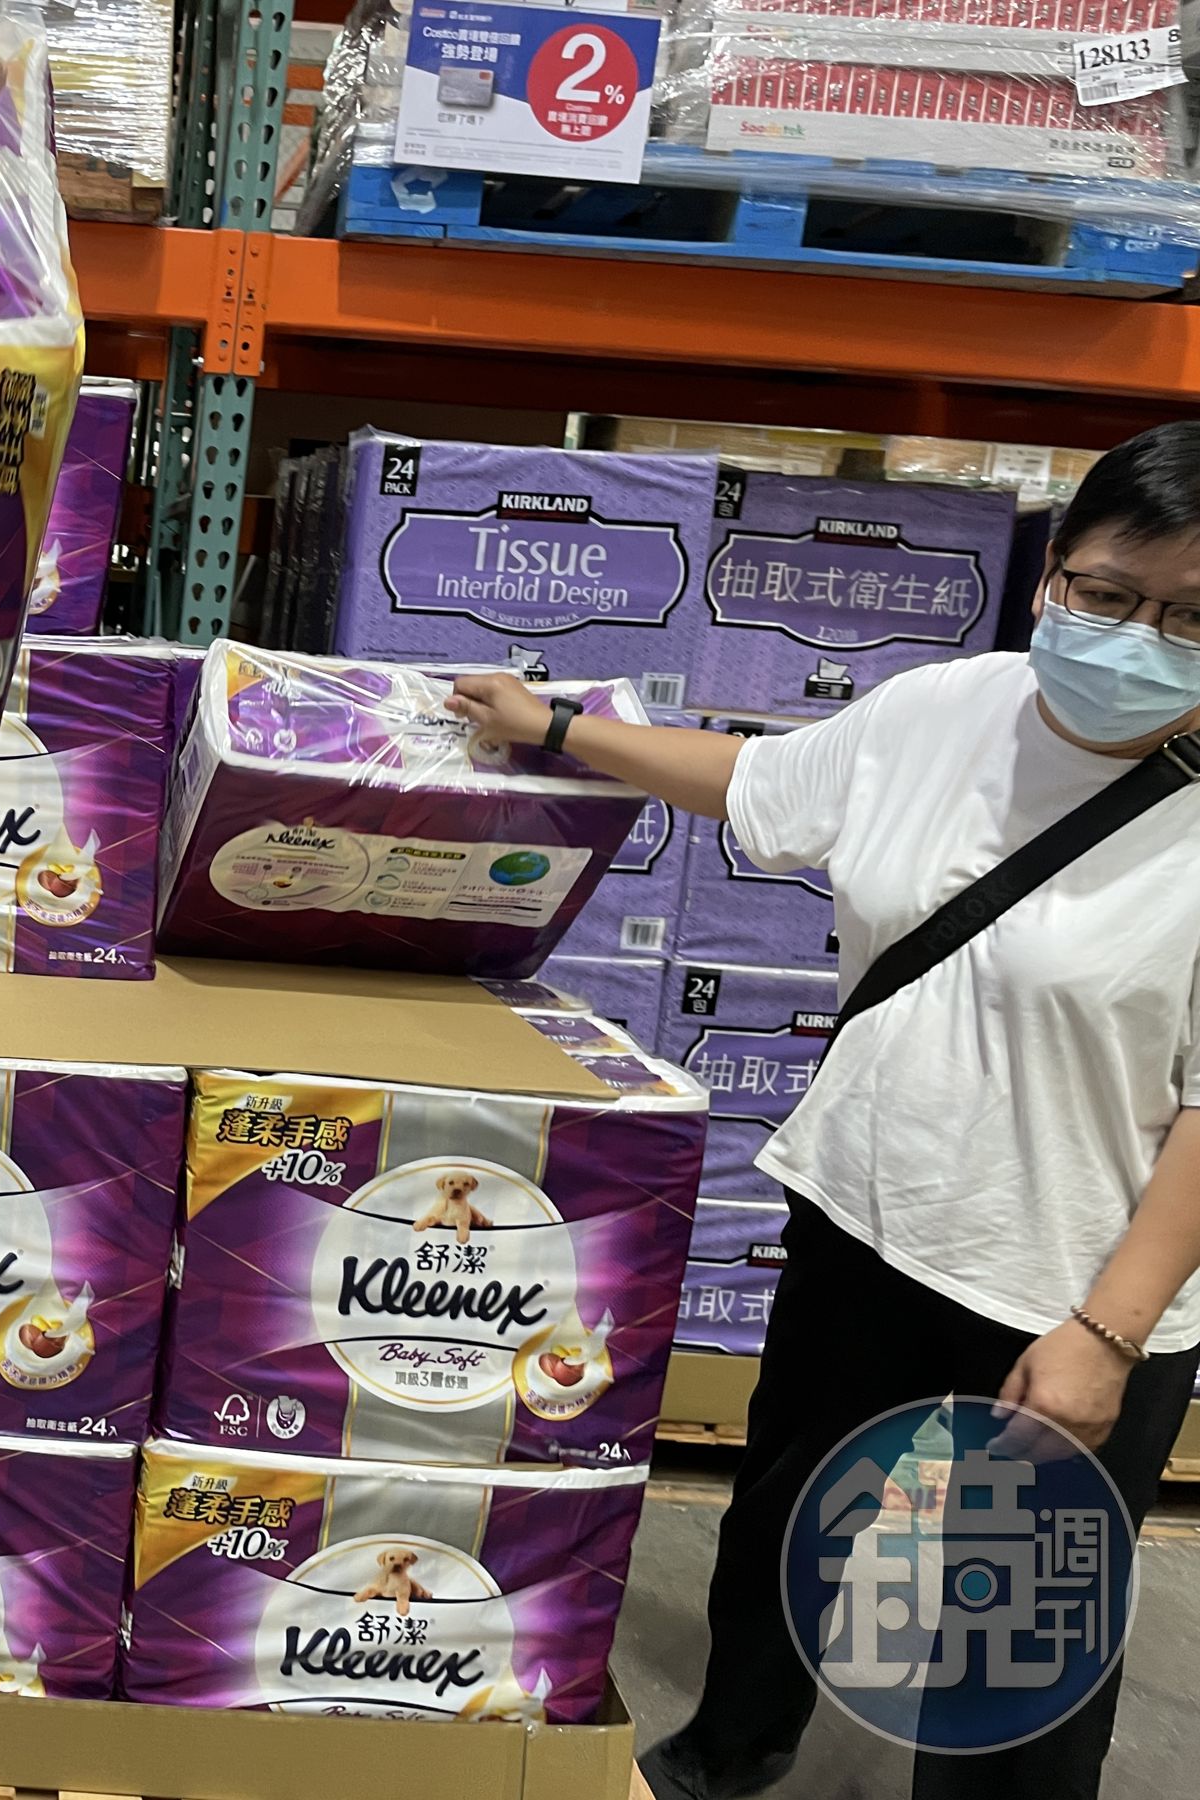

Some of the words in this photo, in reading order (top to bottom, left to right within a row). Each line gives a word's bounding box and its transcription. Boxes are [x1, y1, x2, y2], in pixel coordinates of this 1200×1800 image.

[1079, 38, 1151, 70] 128133
[386, 457, 415, 480] 24
[384, 482, 412, 495] PACK
[502, 493, 589, 513] KIRKLAND
[715, 481, 742, 502] 24
[818, 519, 898, 539] KIRKLAND
[468, 524, 608, 578] Tissue
[437, 573, 542, 602] Interfold
[548, 580, 629, 613] Design
[717, 557, 973, 619] 抽取式衛生紙
[688, 977, 716, 999] 24
[245, 1094, 283, 1112] 新升級
[217, 1110, 352, 1151] 蓬柔手感
[261, 1150, 343, 1186] +10%
[414, 1241, 488, 1275] 舒潔
[338, 1255, 549, 1336] Kleenex
[378, 1343, 437, 1368] Baby
[437, 1348, 487, 1371] Soft
[395, 1371, 469, 1390] 頂級3層舒適
[220, 1424, 248, 1437] FSC
[191, 1474, 229, 1491] 新升級
[163, 1489, 294, 1529] 蓬柔手感
[208, 1527, 288, 1561] +10%
[356, 1611, 428, 1647] 舒潔
[280, 1624, 485, 1697] Kleenex
